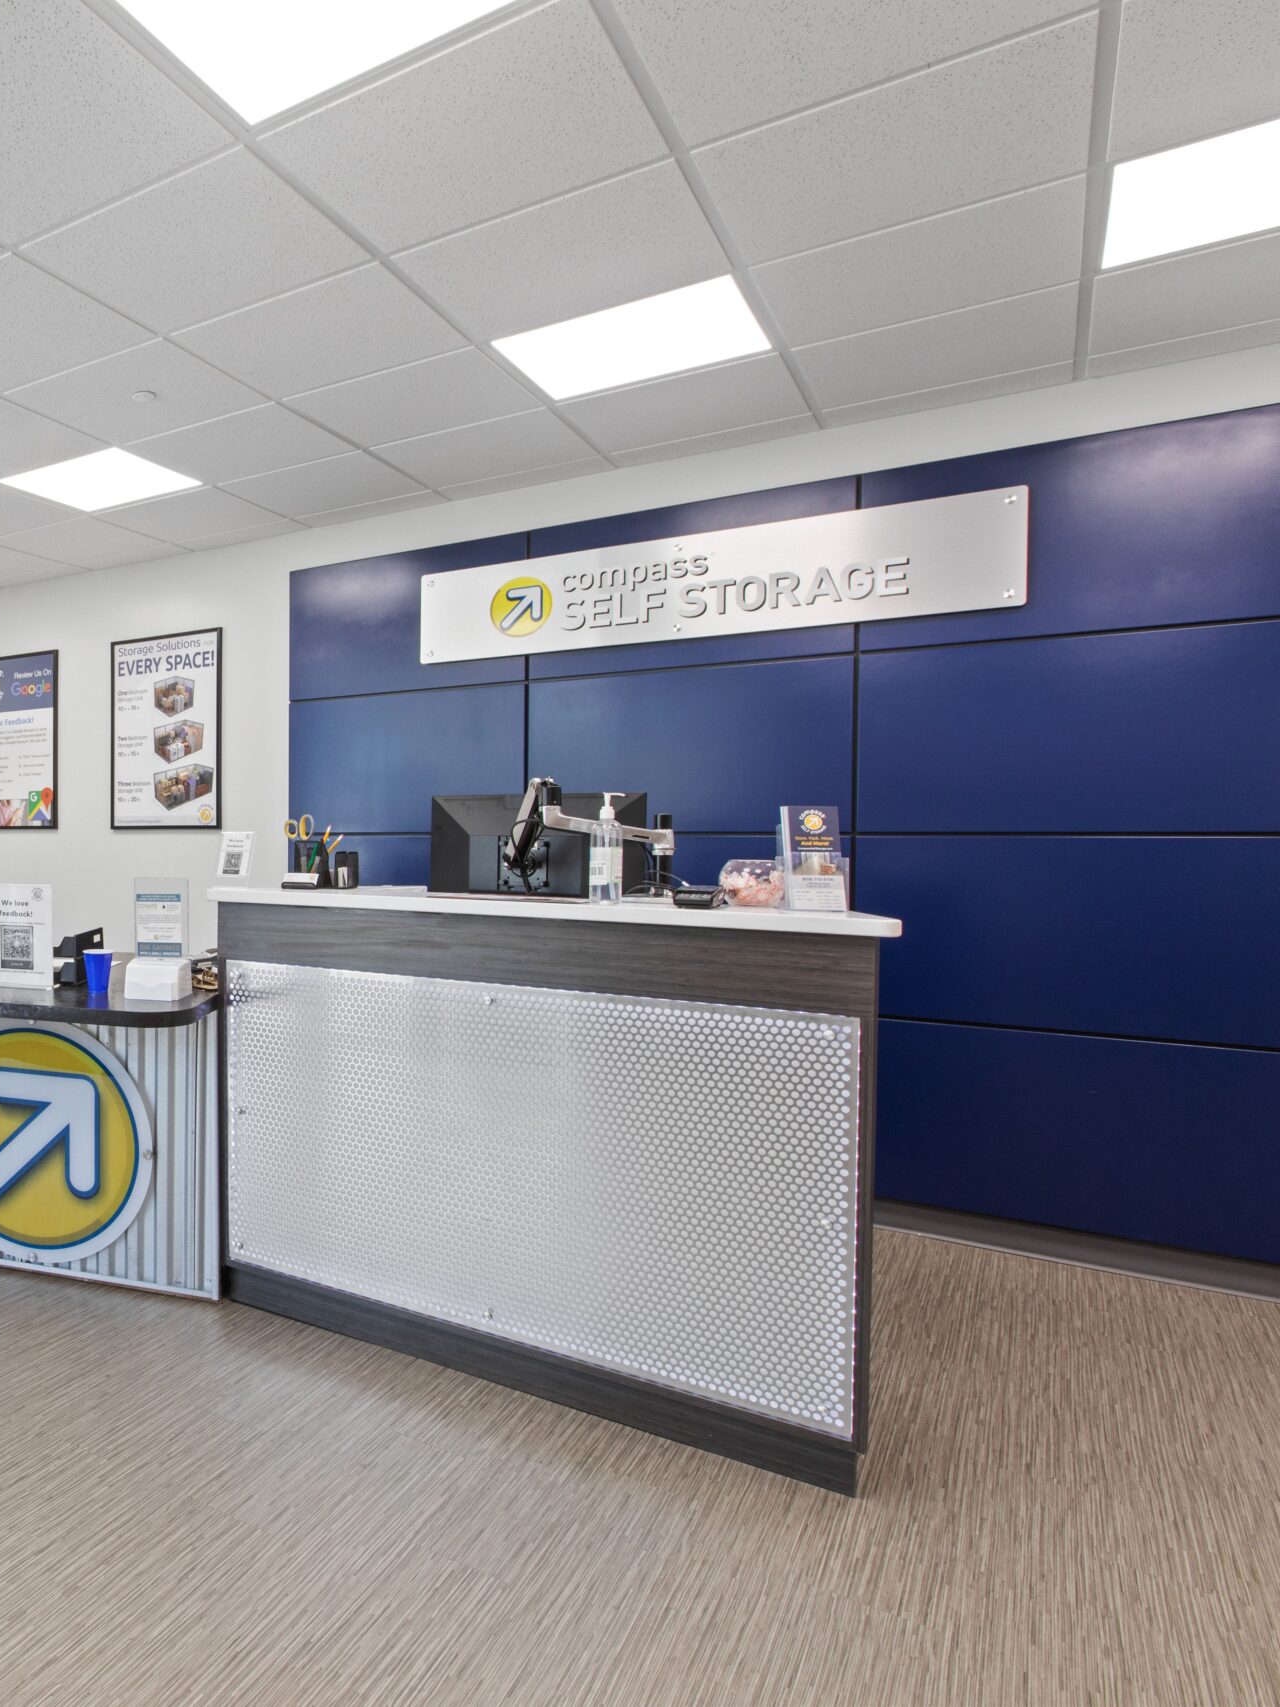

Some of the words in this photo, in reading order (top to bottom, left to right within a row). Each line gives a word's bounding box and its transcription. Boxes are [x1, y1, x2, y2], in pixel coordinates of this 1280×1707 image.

[561, 554, 708, 592] compass
[560, 588, 667, 631] SELF
[679, 556, 910, 618] STORAGE
[118, 645, 154, 658] Storage
[156, 639, 201, 652] Solutions
[117, 657, 162, 677] EVERY
[165, 650, 215, 672] SPACE!
[14, 672, 33, 680] Review
[43, 668, 52, 676] On
[11, 679, 52, 697] Google
[5, 716, 34, 726] Feedback!
[799, 809, 826, 820] compass
[0, 909, 33, 917] feedback!
